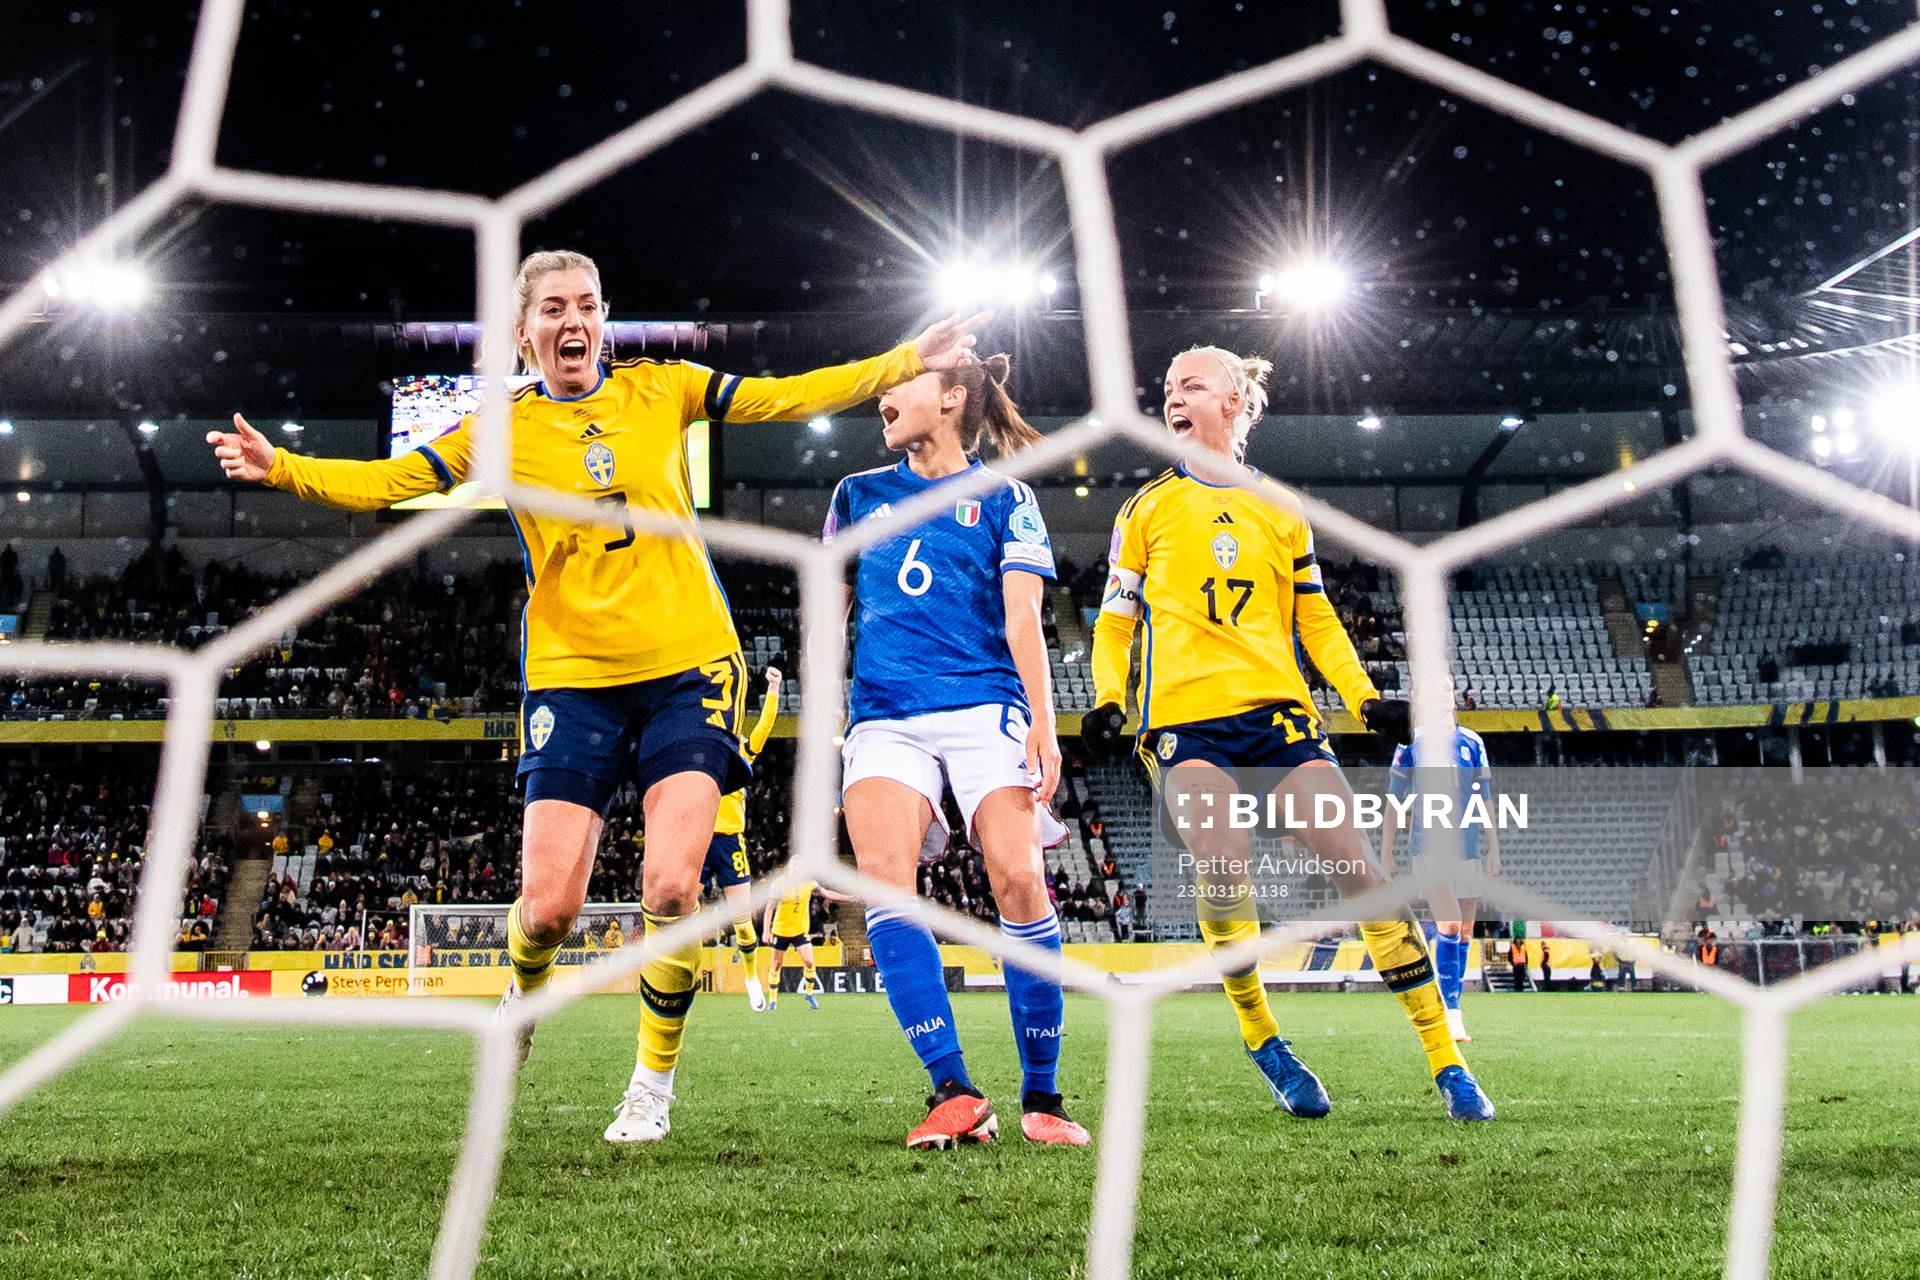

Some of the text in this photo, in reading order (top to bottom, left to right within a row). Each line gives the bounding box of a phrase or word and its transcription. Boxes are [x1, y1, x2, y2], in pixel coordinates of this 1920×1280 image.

[897, 539, 933, 597] 6
[1200, 577, 1255, 627] 17
[700, 660, 734, 711] 3
[1272, 707, 1319, 744] 17
[732, 851, 744, 872] 8
[333, 975, 371, 989] Steve
[905, 1016, 946, 1041] ITALIA
